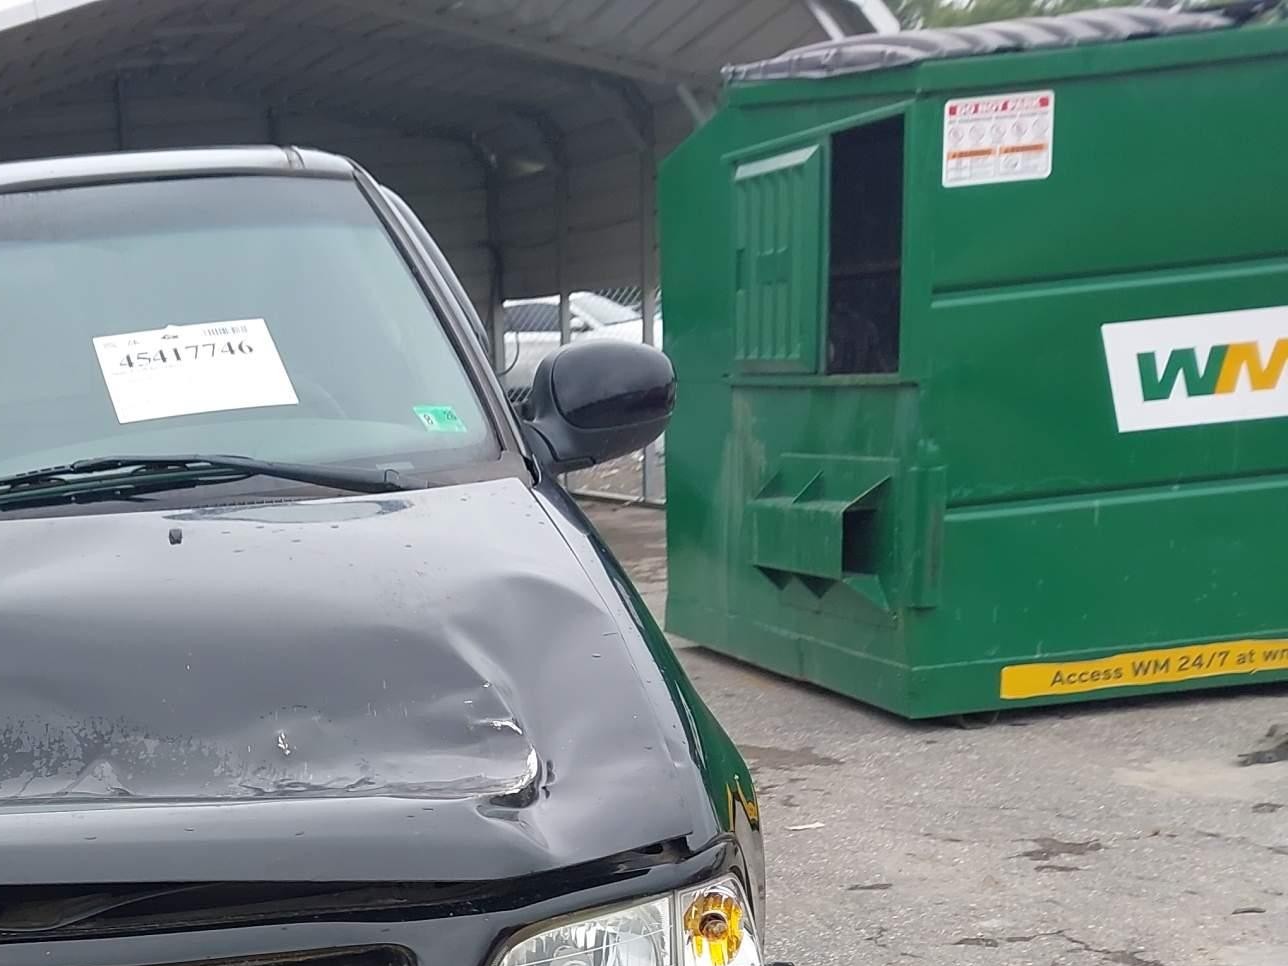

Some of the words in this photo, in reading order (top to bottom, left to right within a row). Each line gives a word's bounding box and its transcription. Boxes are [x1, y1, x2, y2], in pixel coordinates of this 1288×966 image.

[119, 340, 253, 369] 45417746
[1136, 336, 1288, 402] WM
[1050, 667, 1123, 687] Access
[1131, 660, 1170, 677] WM
[1177, 650, 1231, 671] 24/7
[1236, 648, 1256, 665] at
